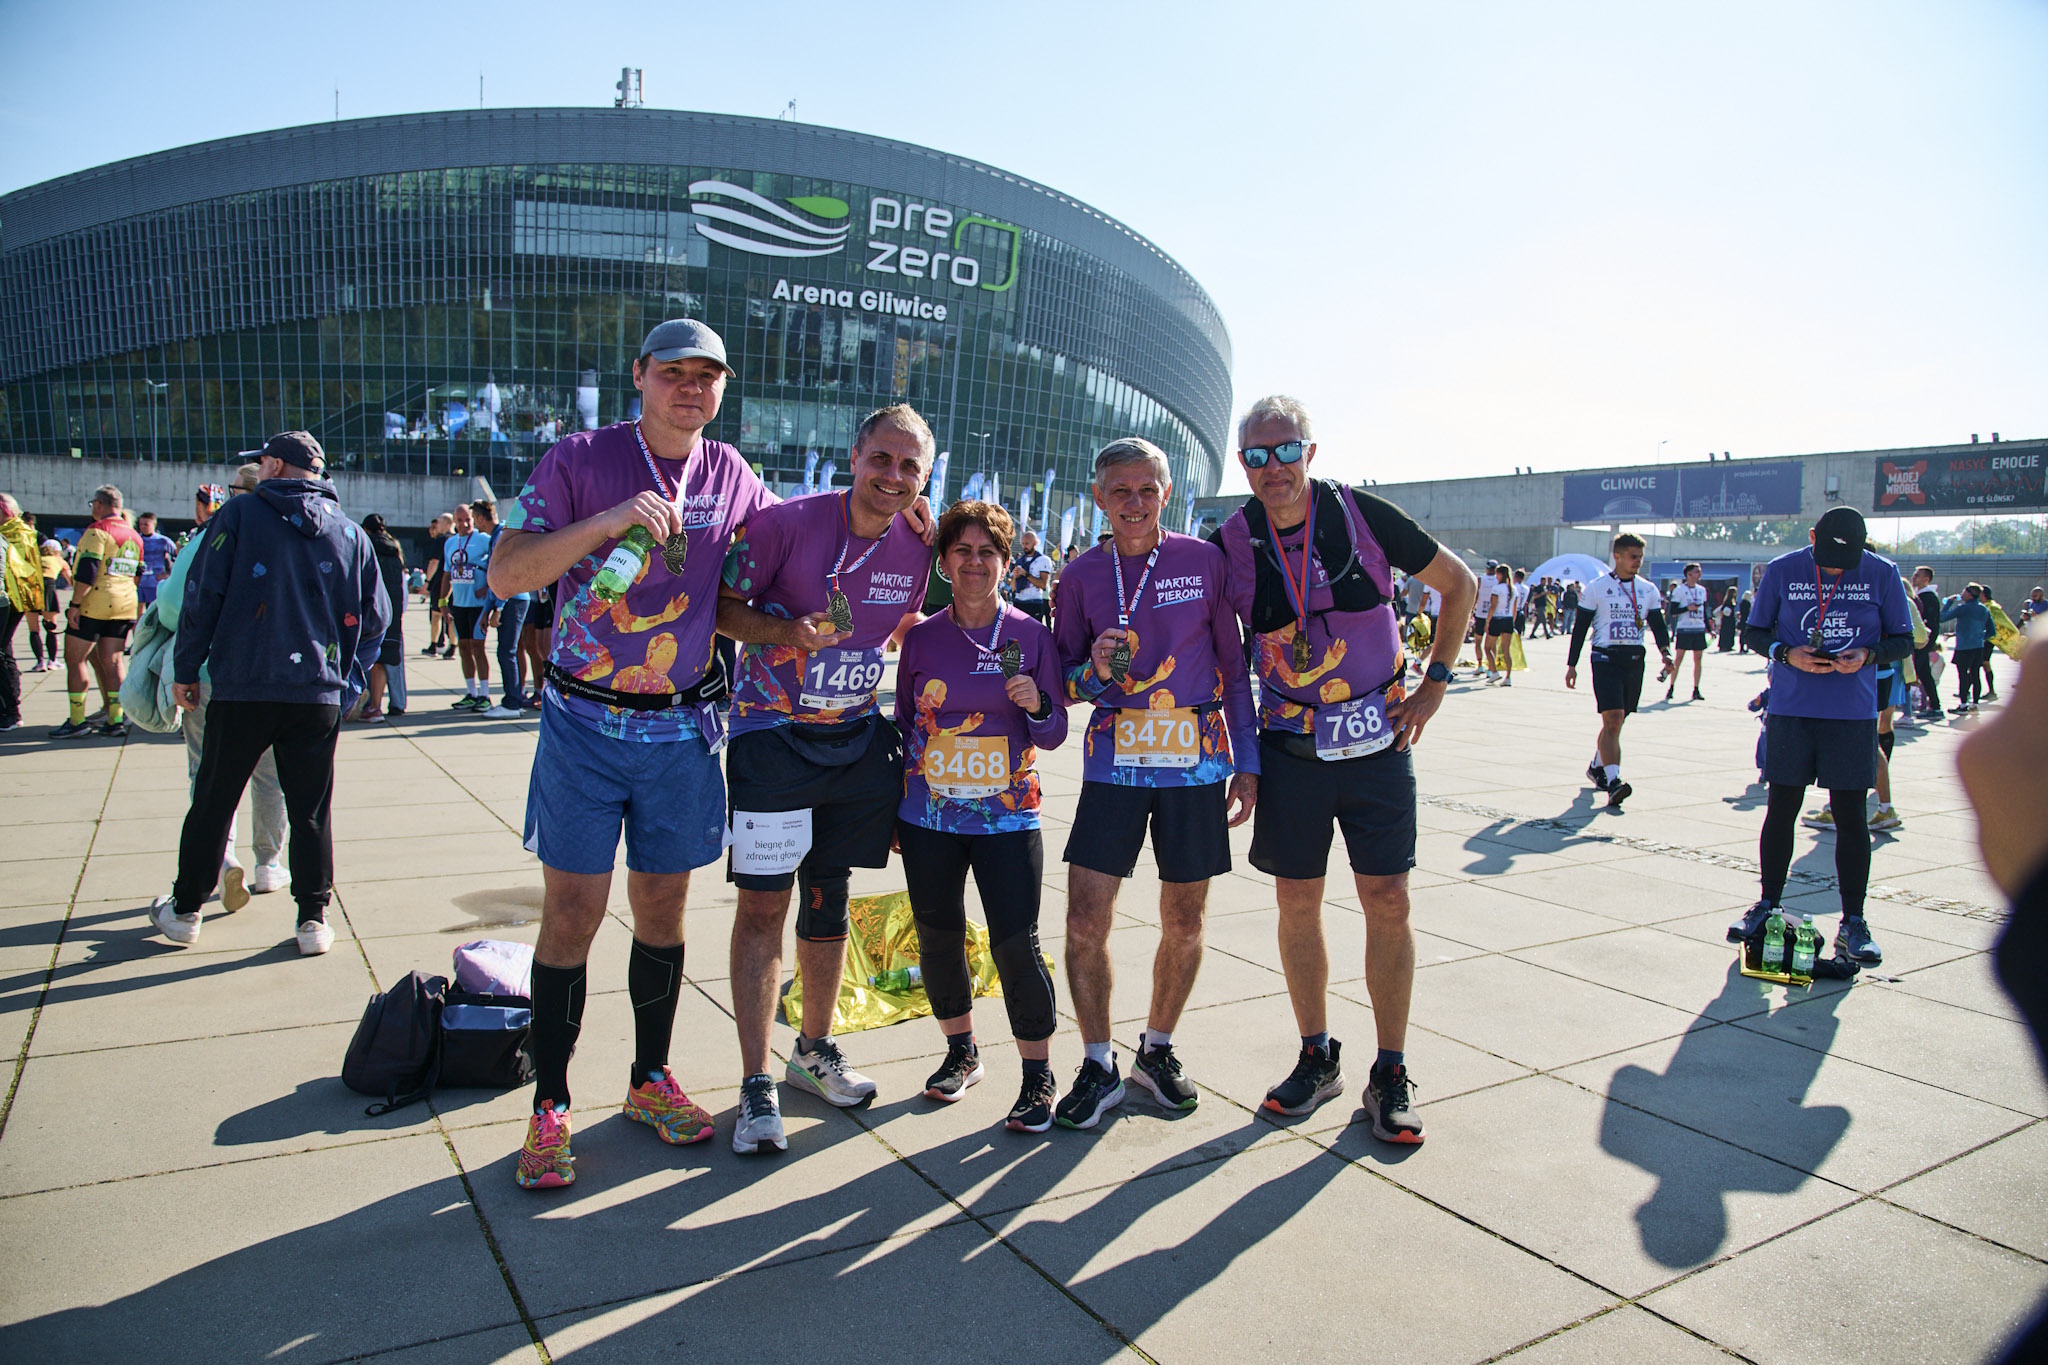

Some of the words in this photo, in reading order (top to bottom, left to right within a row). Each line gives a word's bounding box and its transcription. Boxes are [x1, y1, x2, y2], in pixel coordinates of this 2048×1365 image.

[868, 197, 953, 238] pre
[866, 241, 979, 287] zero
[772, 279, 852, 308] Arena
[859, 290, 947, 321] Gliwice
[1950, 457, 1987, 472] NASYĆ
[1992, 455, 2040, 470] EMOCJE
[1601, 477, 1656, 491] GLIWICE
[1888, 471, 1919, 484] MADEJ
[685, 494, 726, 508] WARTKIE
[683, 510, 726, 524] PIERONY
[871, 572, 913, 587] WARTKIE
[1155, 575, 1202, 590] WARTKIE
[1843, 583, 1870, 591] HALF
[868, 587, 911, 602] PIERONY
[1157, 589, 1204, 603] PIERONY
[1788, 592, 1845, 600] MARAHN
[1816, 618, 1846, 628] AFE
[1611, 626, 1638, 638] 1353
[1807, 627, 1853, 638] Saces
[811, 662, 880, 691] 1469
[1326, 706, 1382, 742] 768
[1119, 719, 1195, 748] 3470
[928, 750, 1005, 779] 3468
[755, 840, 782, 851] biegnę
[784, 839, 795, 848] dla
[745, 852, 778, 862] zdrowej
[780, 851, 801, 862] głowy
